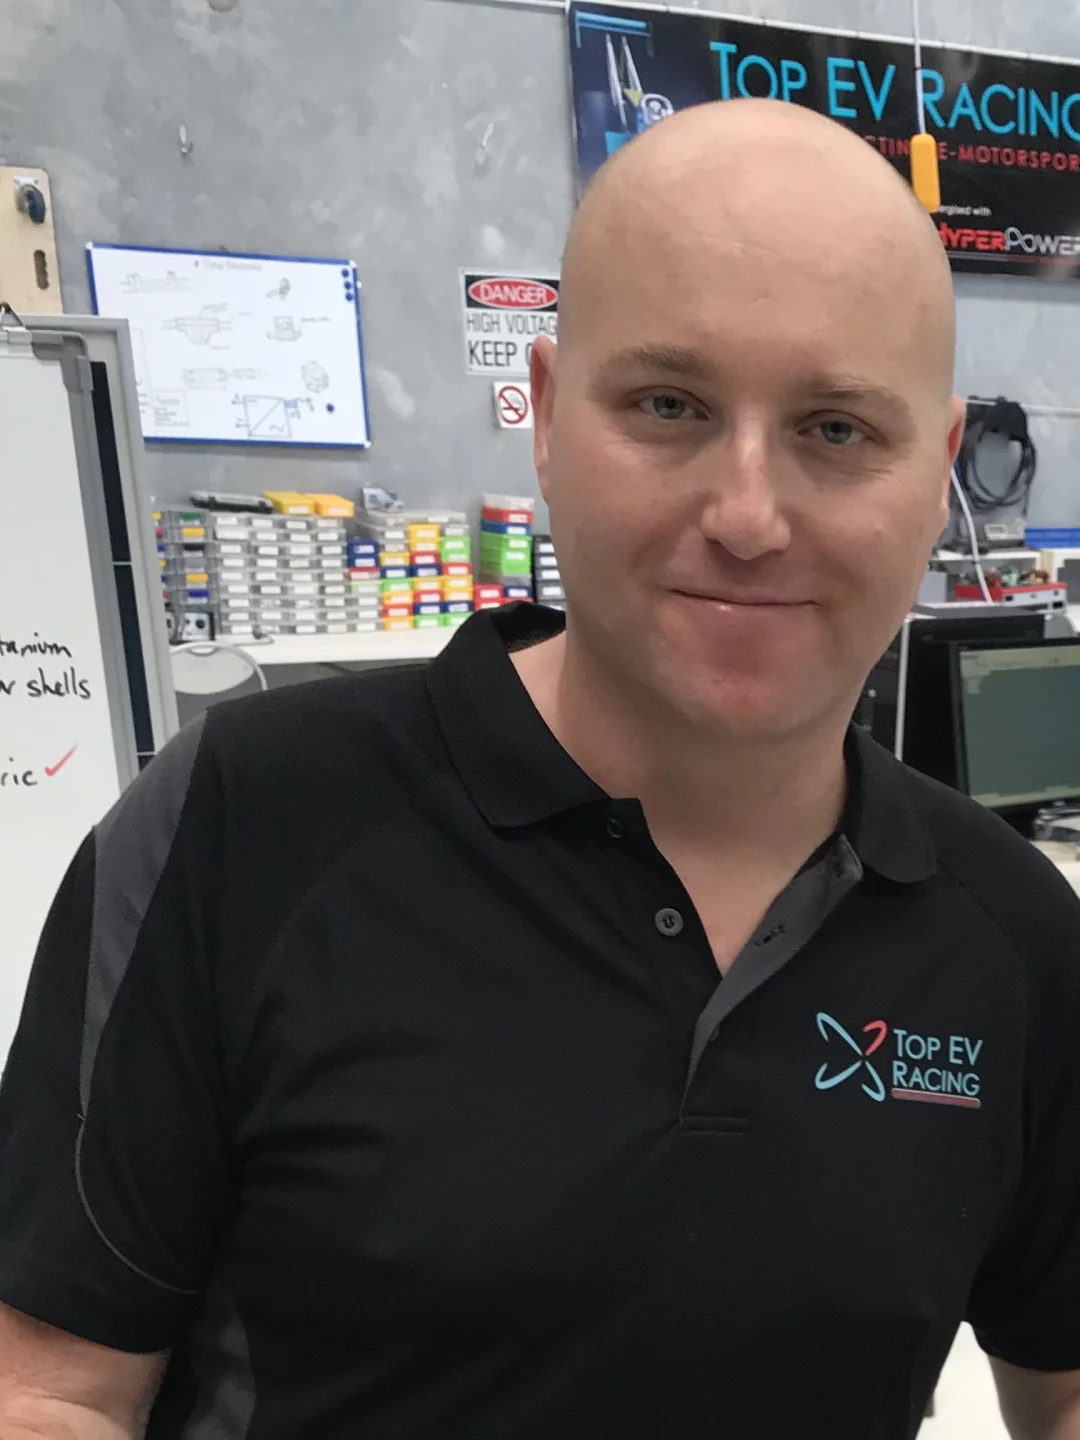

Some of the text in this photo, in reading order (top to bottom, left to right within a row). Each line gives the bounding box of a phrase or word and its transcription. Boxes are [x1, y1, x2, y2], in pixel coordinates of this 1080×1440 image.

[709, 41, 808, 103] TOP
[827, 57, 896, 121] EV
[479, 283, 548, 304] DANGER
[466, 312, 557, 336] HIGH VOLTAG
[467, 340, 518, 367] KEEP
[26, 667, 91, 700] shells
[0, 757, 38, 786] ric
[893, 1029, 983, 1065] TOP EV
[892, 1060, 980, 1096] RACING
